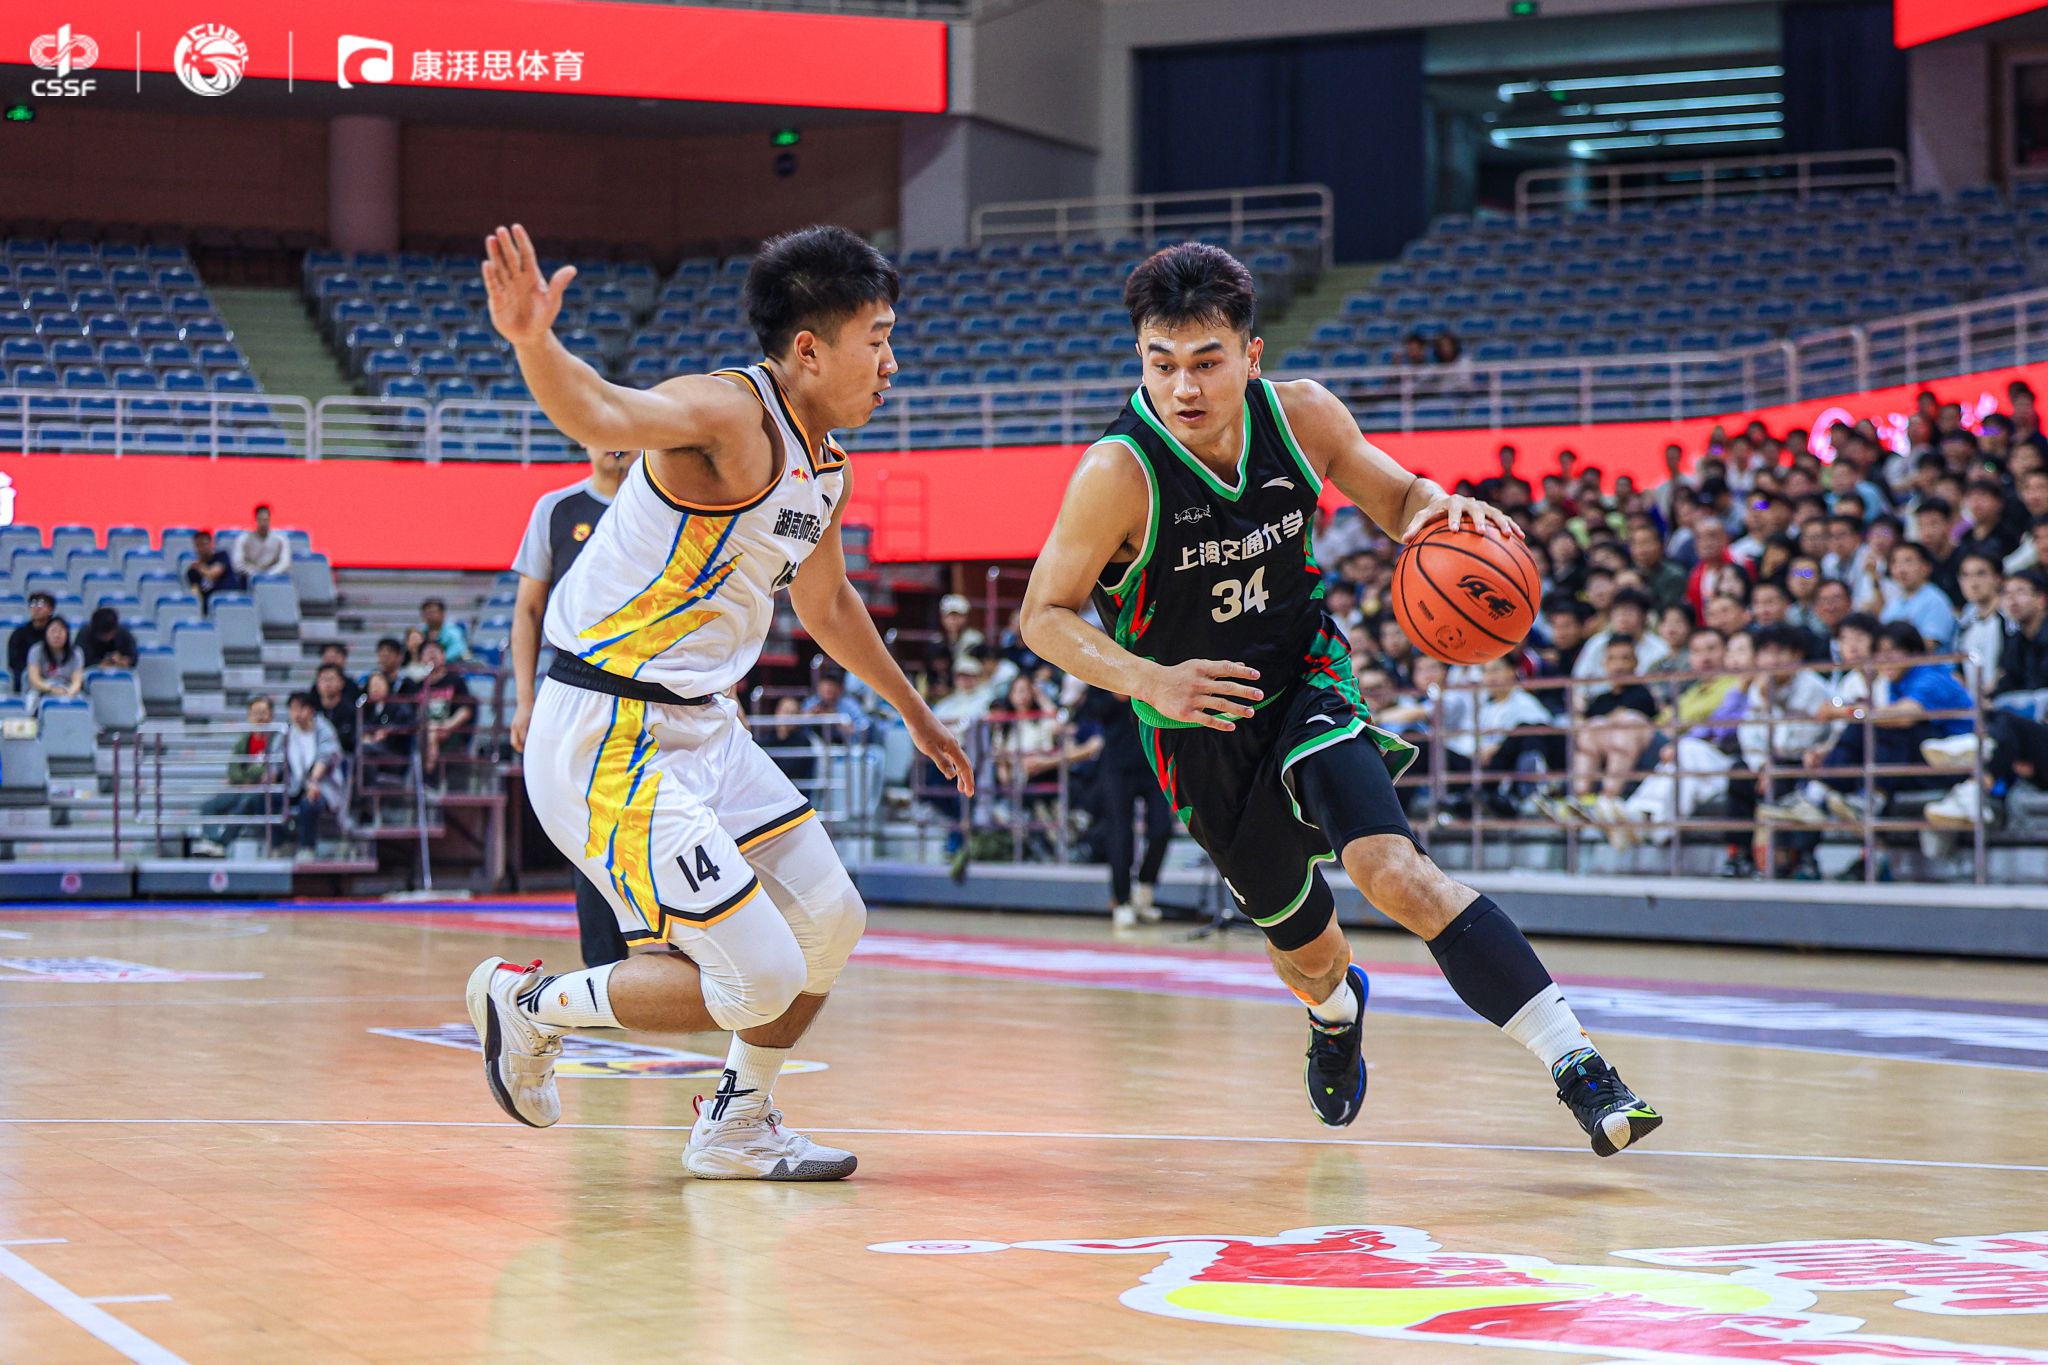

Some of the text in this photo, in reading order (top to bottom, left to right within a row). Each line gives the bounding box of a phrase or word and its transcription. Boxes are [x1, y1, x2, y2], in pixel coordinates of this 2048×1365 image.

[1174, 508, 1305, 572] 上海交通大学
[1211, 565, 1270, 623] 34
[676, 844, 720, 894] 14
